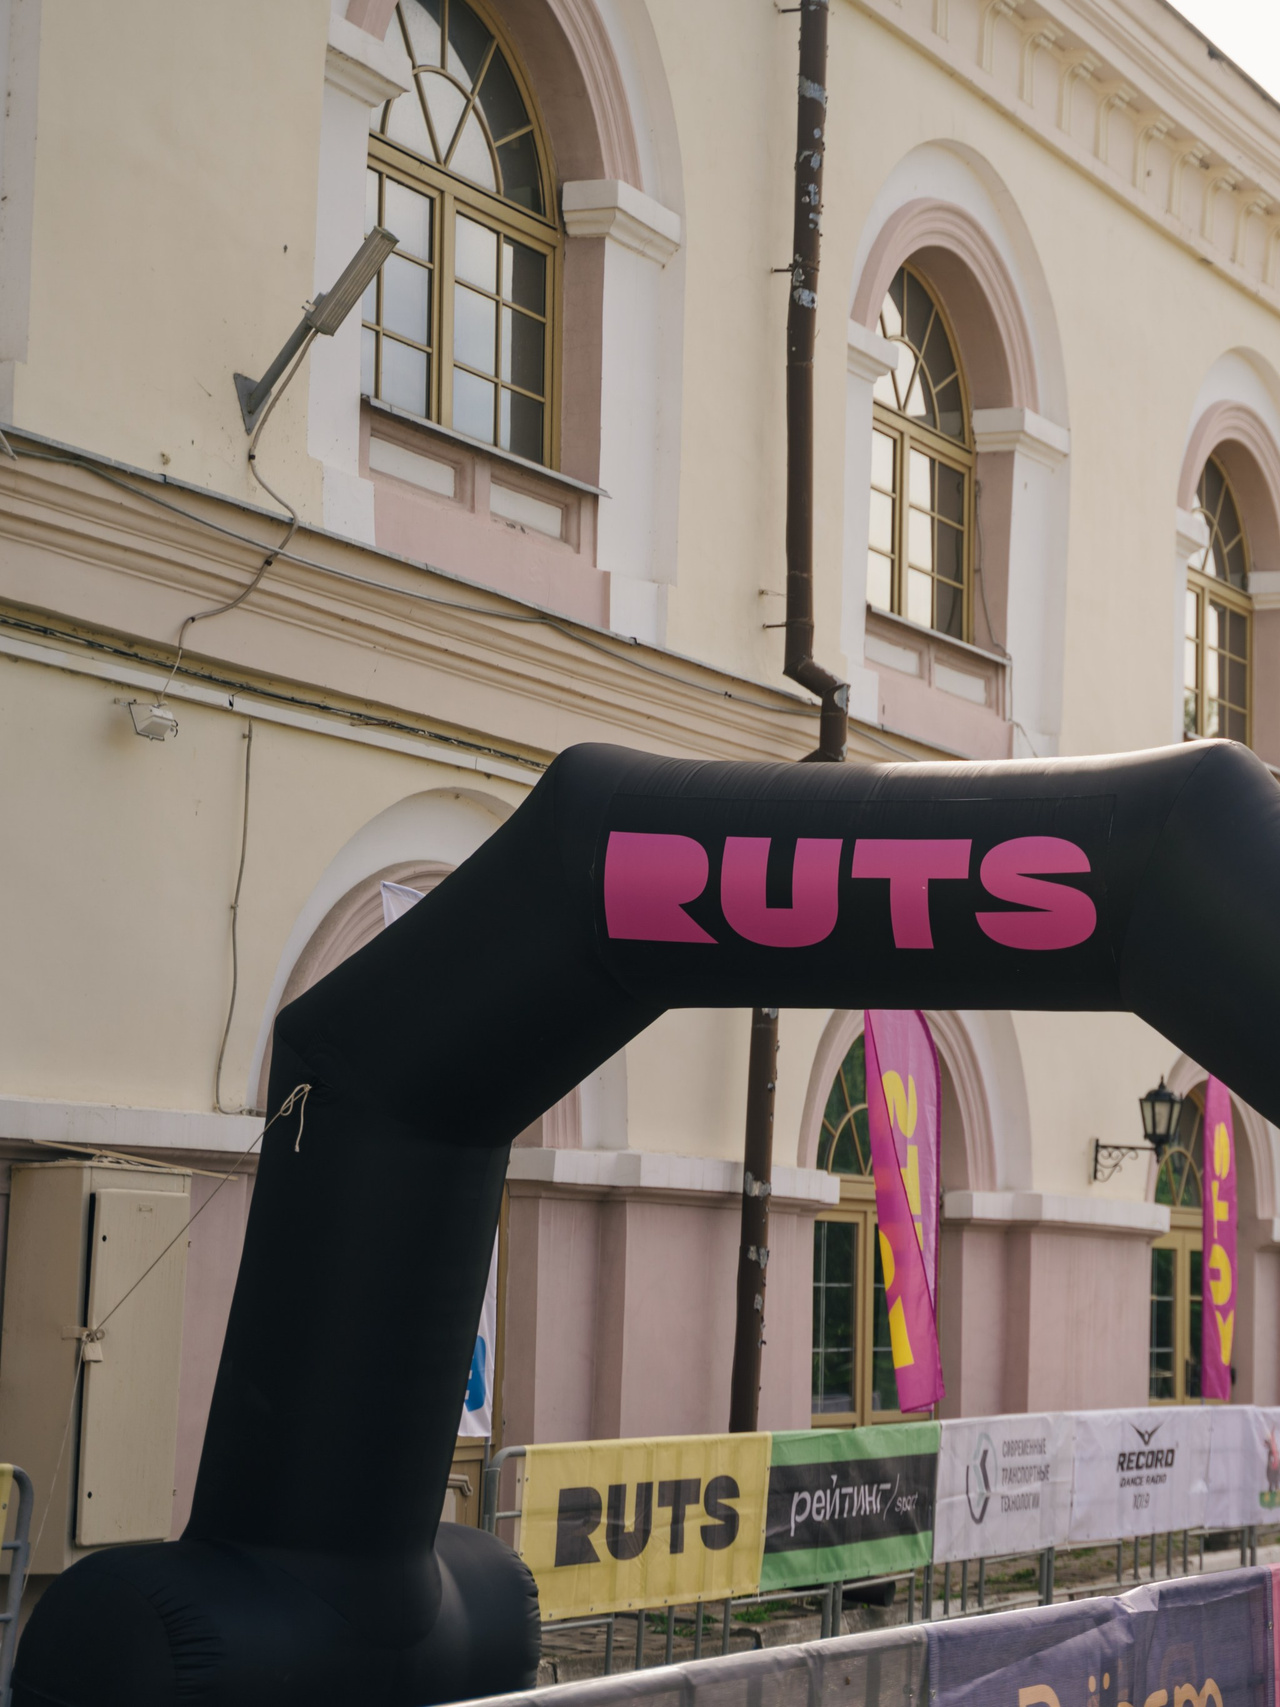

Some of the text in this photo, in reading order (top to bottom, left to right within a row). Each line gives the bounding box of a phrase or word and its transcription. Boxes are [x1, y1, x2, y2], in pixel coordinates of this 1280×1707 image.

[604, 831, 1097, 950] RUTS
[1117, 1449, 1175, 1473] RECORD
[1120, 1473, 1167, 1488] DANCE RADIO
[554, 1475, 740, 1568] RUTS
